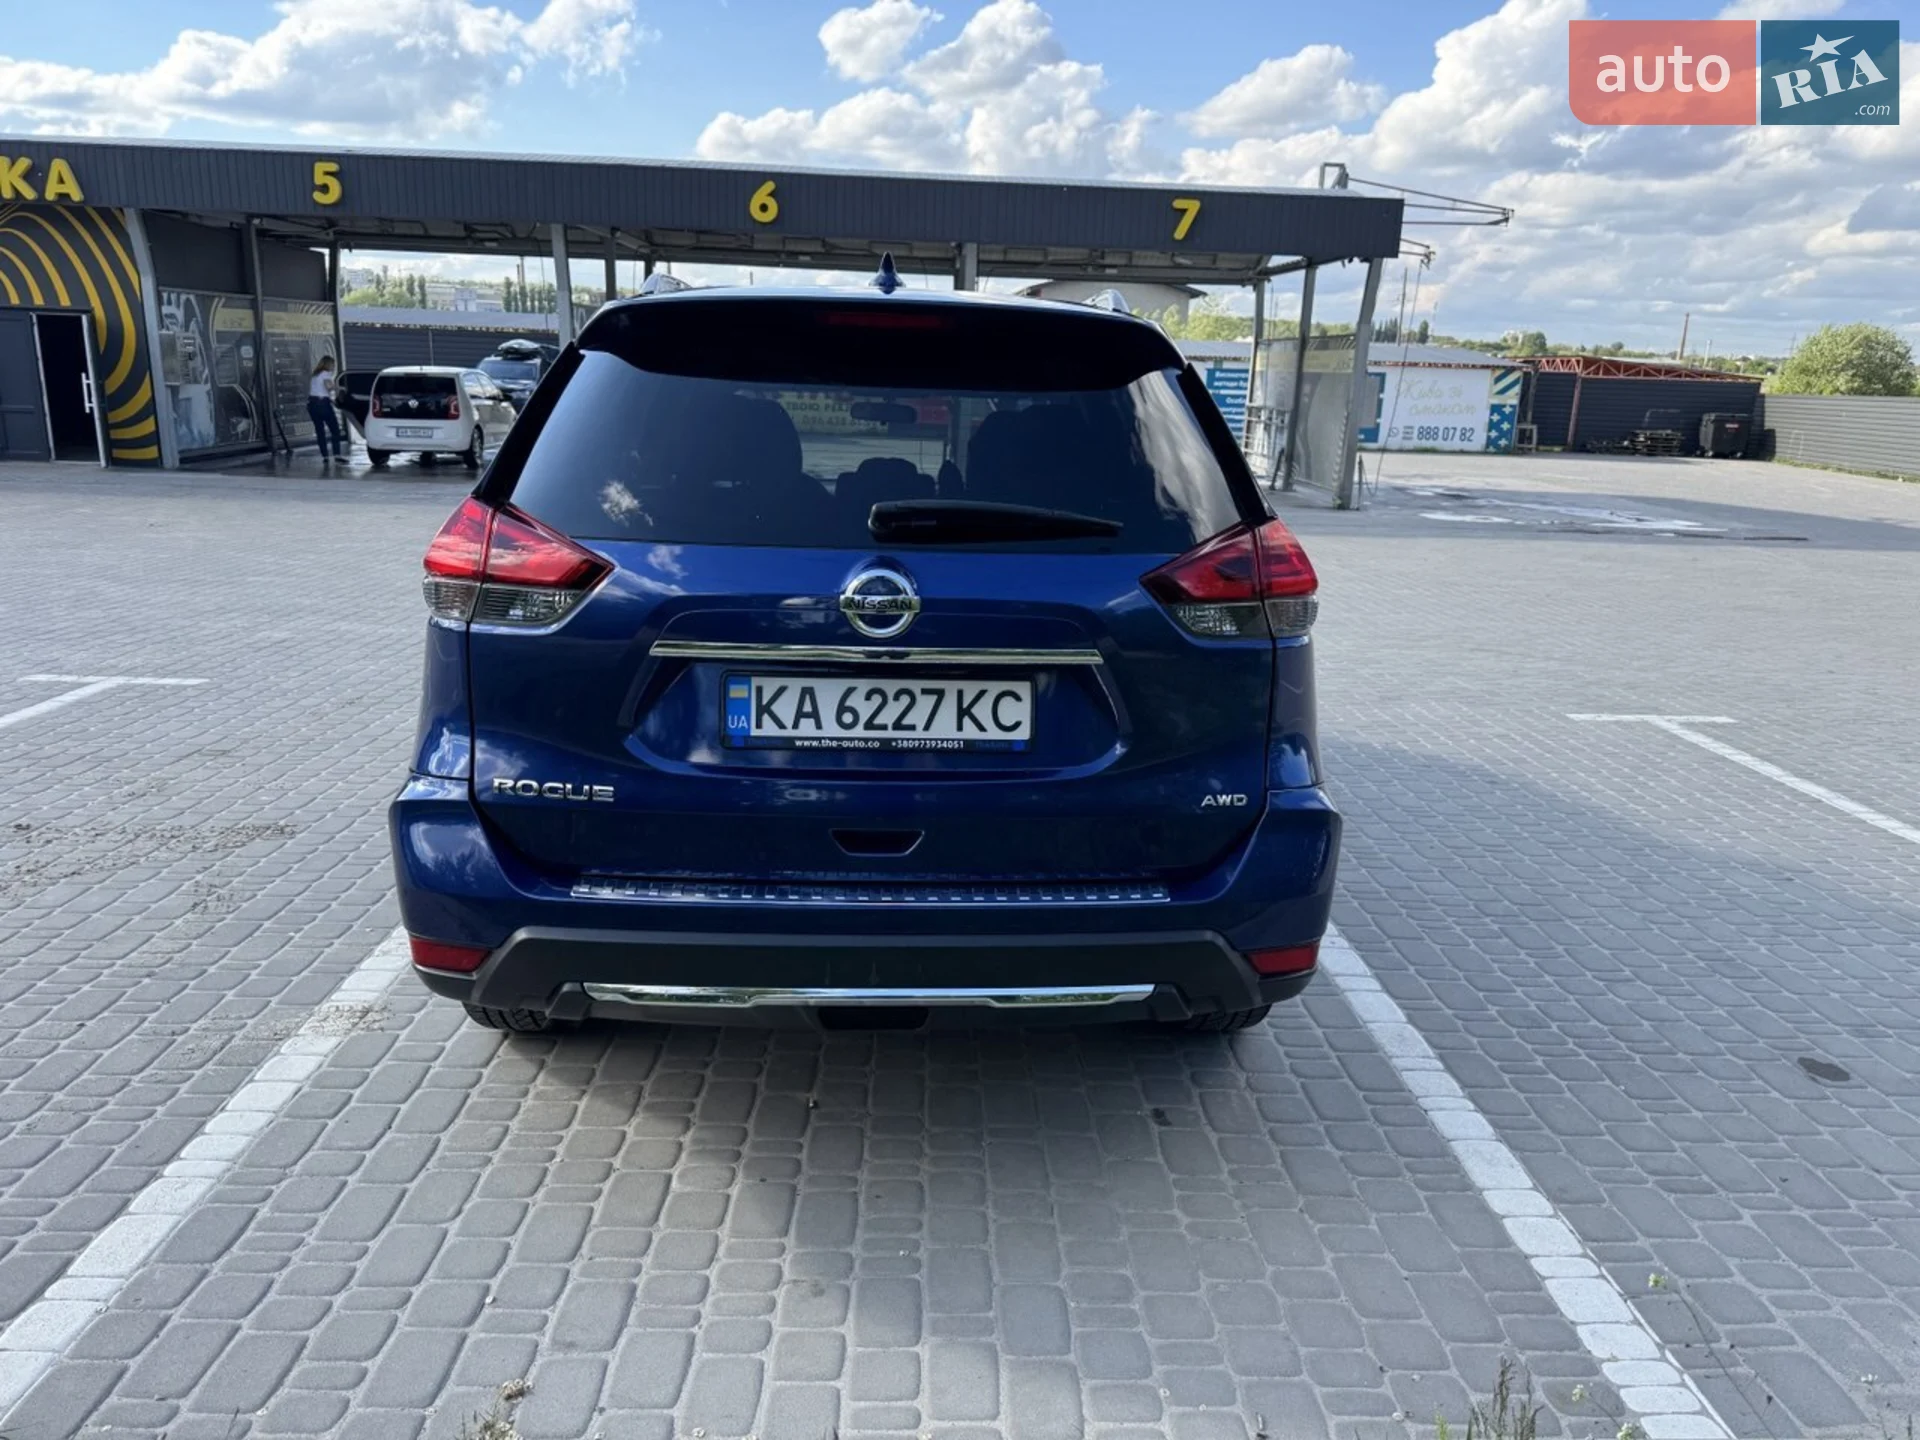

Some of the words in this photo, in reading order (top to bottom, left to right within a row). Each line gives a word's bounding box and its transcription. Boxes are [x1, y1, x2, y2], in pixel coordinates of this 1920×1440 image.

[313, 162, 342, 204] 5
[749, 180, 778, 222] 6
[1172, 199, 1201, 240] 7
[1417, 425, 1439, 441] 888
[1441, 426, 1457, 442] 07
[1459, 427, 1475, 442] 82
[848, 598, 912, 611] NISSAN
[755, 685, 823, 731] KA
[835, 686, 946, 731] 6227
[956, 688, 1023, 733] KC
[728, 714, 749, 729] UA
[492, 778, 615, 802] ROGUE
[1201, 794, 1248, 807] AWD
